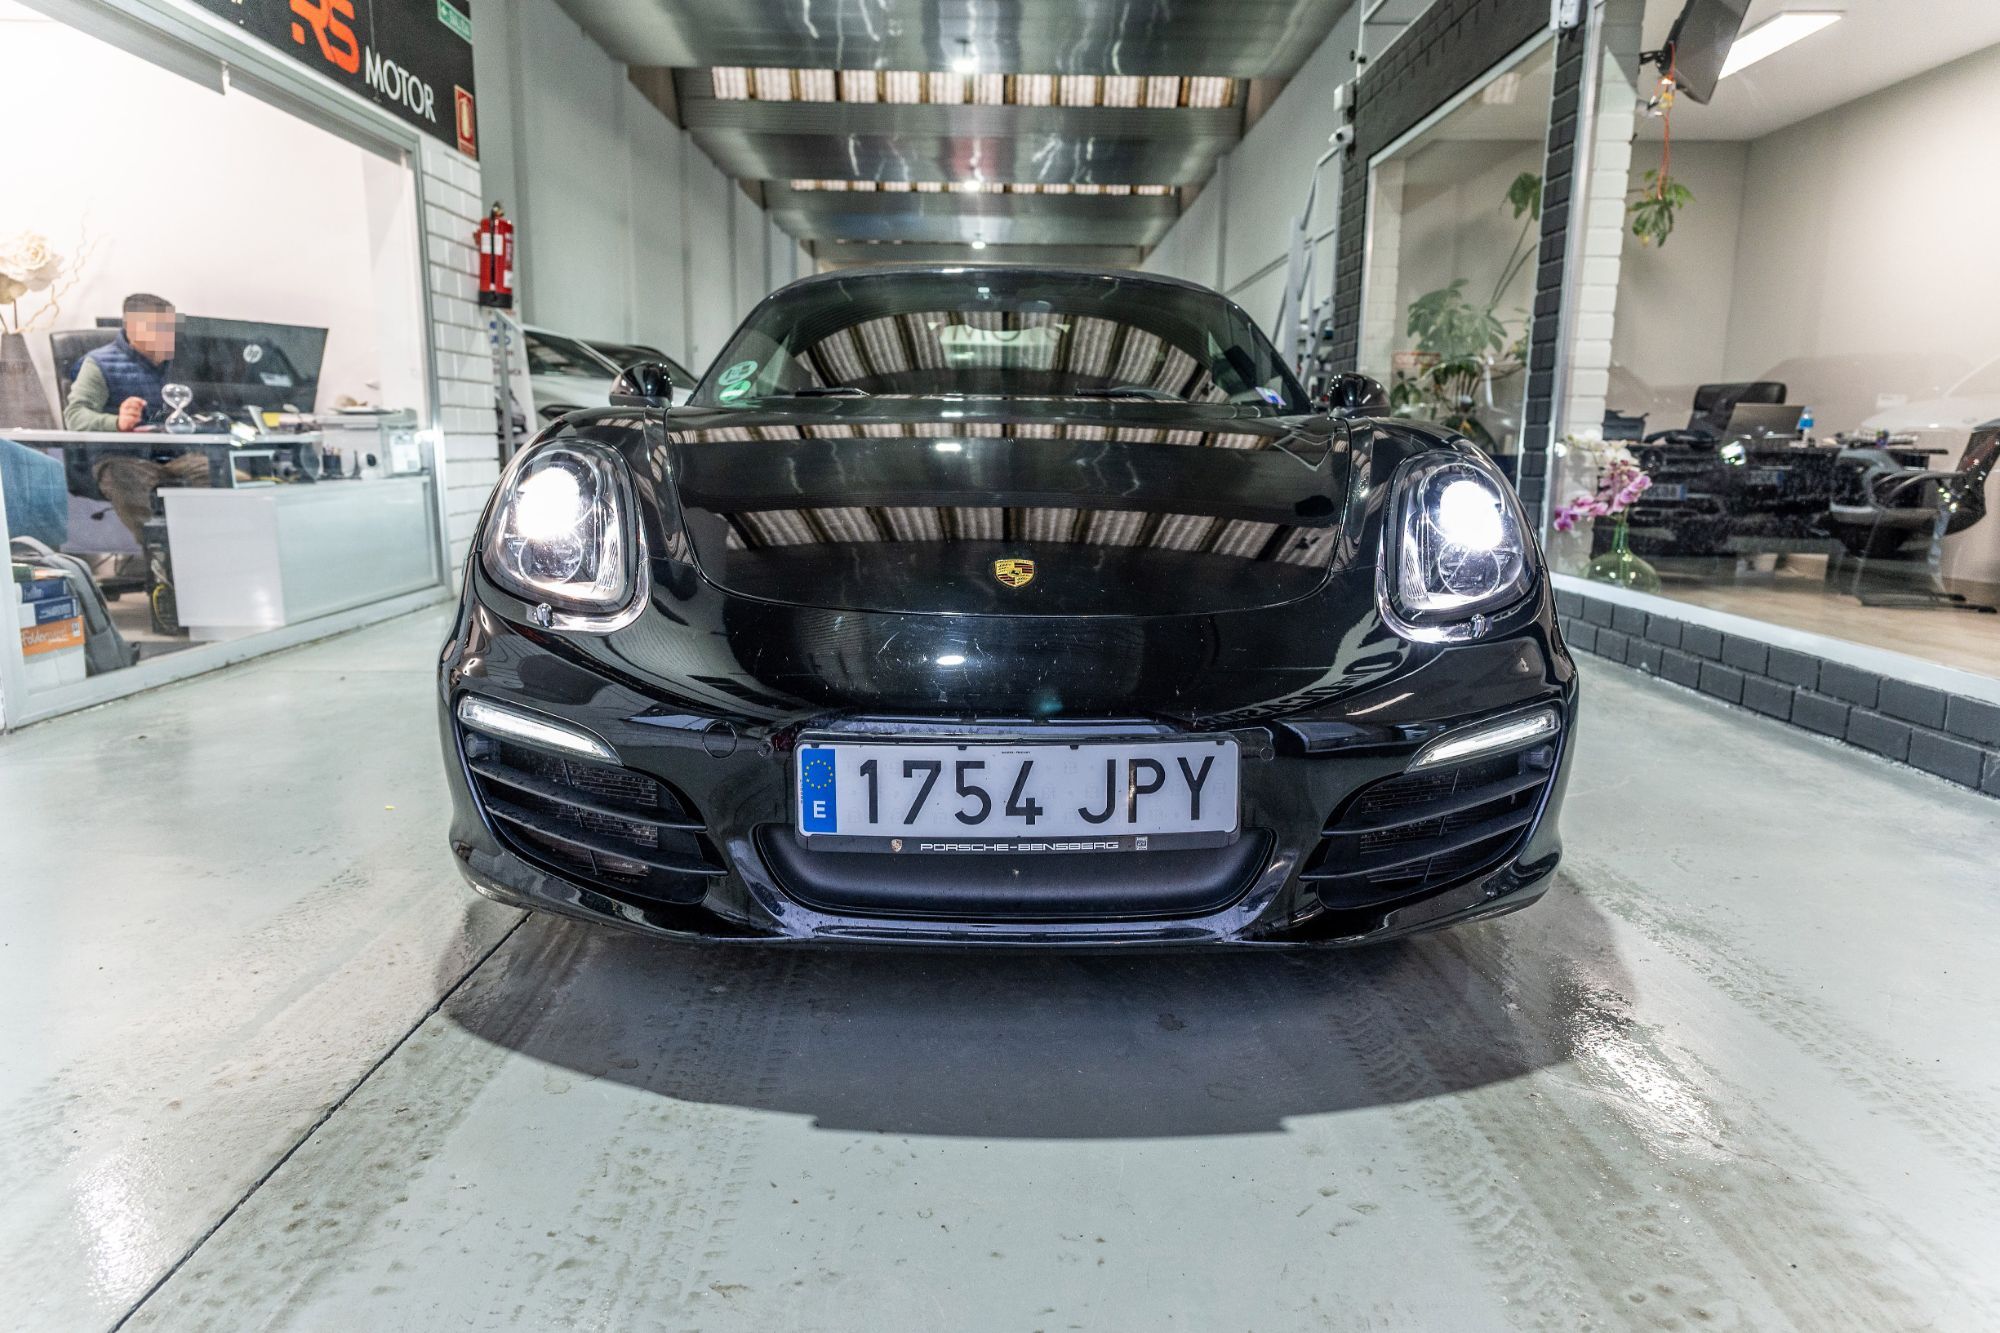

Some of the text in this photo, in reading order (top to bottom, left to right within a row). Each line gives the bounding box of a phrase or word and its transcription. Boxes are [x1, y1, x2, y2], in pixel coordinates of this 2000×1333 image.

[365, 45, 437, 123] MOTOR
[813, 800, 826, 819] E
[859, 755, 1215, 826] 1754 JPY
[920, 841, 1119, 852] PORSCHE-BENSBERG
